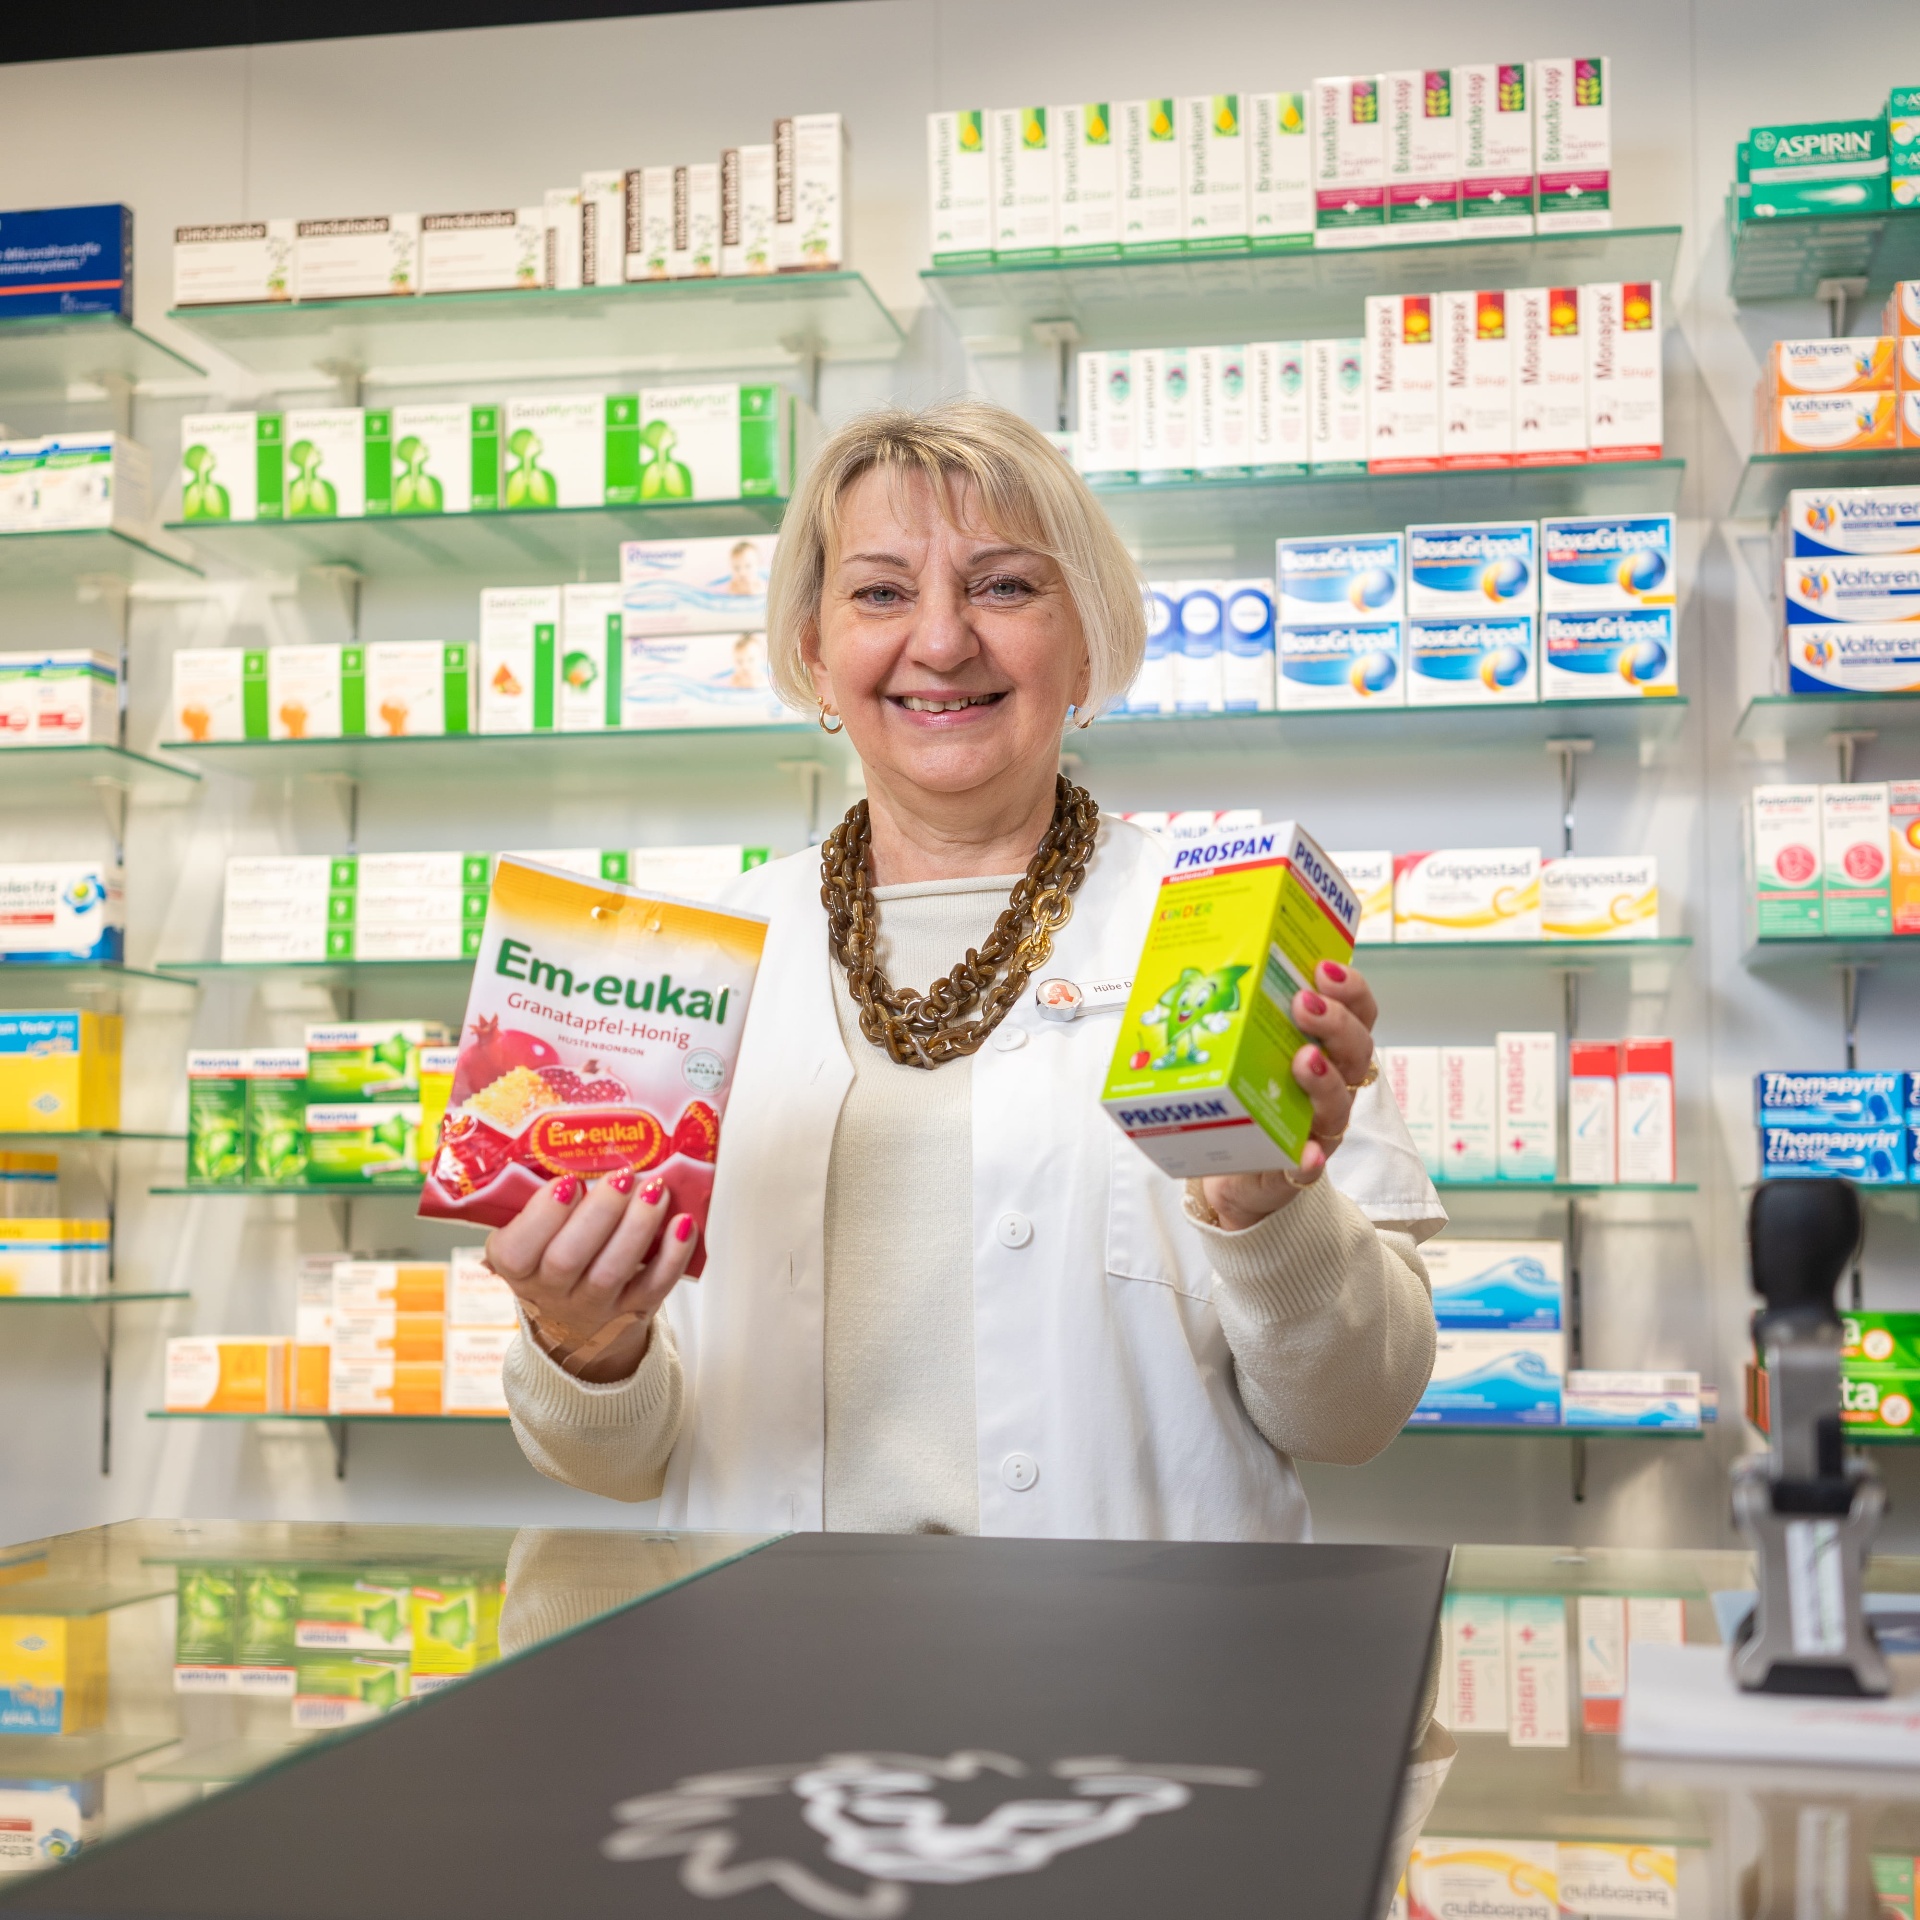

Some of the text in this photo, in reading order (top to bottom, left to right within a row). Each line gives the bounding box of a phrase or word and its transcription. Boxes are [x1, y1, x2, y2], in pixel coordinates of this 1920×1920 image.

[1774, 131, 1871, 158] ASPIRIN
[1376, 305, 1395, 392] Monapax
[1448, 300, 1472, 388] Monapax
[1522, 298, 1542, 385] Monapax
[1595, 293, 1616, 380] Monapax
[1788, 344, 1850, 356] Voltaren
[1789, 400, 1852, 412] Voltaren
[1413, 534, 1528, 559] BoxaGrippal
[1547, 525, 1666, 552] BoxaGrippal
[1282, 545, 1395, 570] BoxaGrippal
[1832, 568, 1919, 585] Voltaren
[1283, 628, 1397, 653] BoxaGrippal
[1412, 622, 1528, 649] BoxaGrippal
[1548, 615, 1667, 641] BoxaGrippal
[1174, 834, 1275, 869] PROSPAN
[1295, 840, 1355, 924] PROSPAN
[1426, 862, 1531, 880] Grippostad
[1544, 870, 1648, 888] Grippostad
[495, 938, 730, 1025] Em-eukal
[1093, 982, 1122, 993] Hübe
[507, 992, 691, 1048] Granatapfel-Honig
[558, 1034, 645, 1056] HUSTENBONBON
[1501, 1042, 1524, 1114] nasic
[1764, 1073, 1895, 1095] Thomapyrin
[1764, 1092, 1828, 1106] CLASSIC
[1118, 1099, 1228, 1127] PROSPAN
[1767, 1128, 1898, 1151] Thomapyrin
[558, 1150, 574, 1159] von
[1767, 1147, 1831, 1161] CLASSIC
